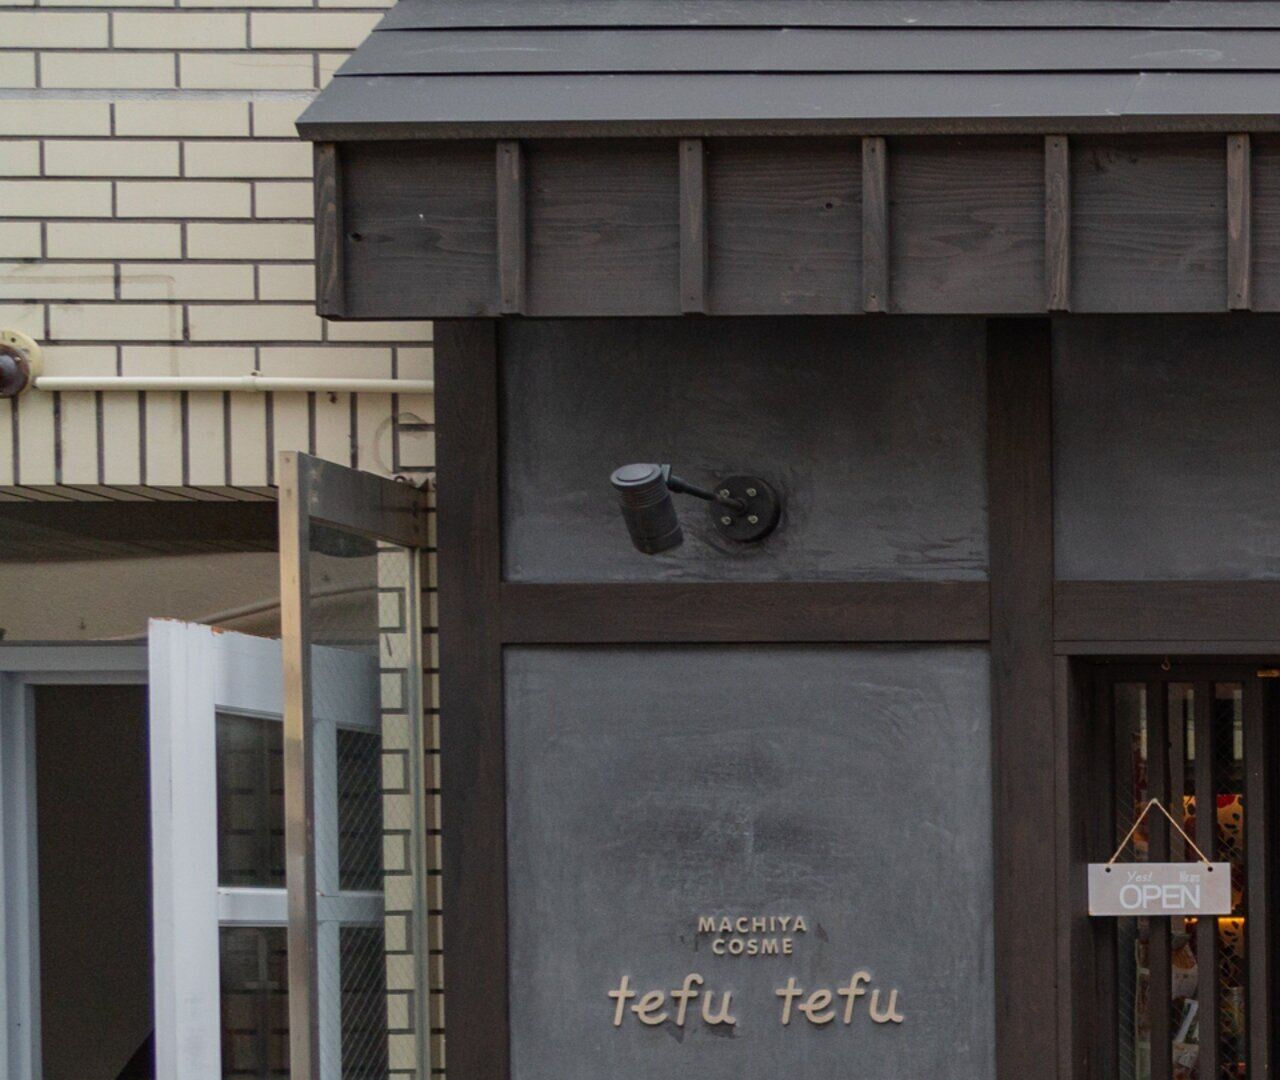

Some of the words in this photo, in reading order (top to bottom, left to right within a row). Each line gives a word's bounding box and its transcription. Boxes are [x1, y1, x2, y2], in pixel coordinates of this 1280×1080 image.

[1119, 883, 1200, 909] OPEN
[698, 915, 808, 934] MACHIYA
[712, 938, 794, 955] COSME
[607, 973, 737, 1027] tefu
[775, 971, 905, 1025] tefu
